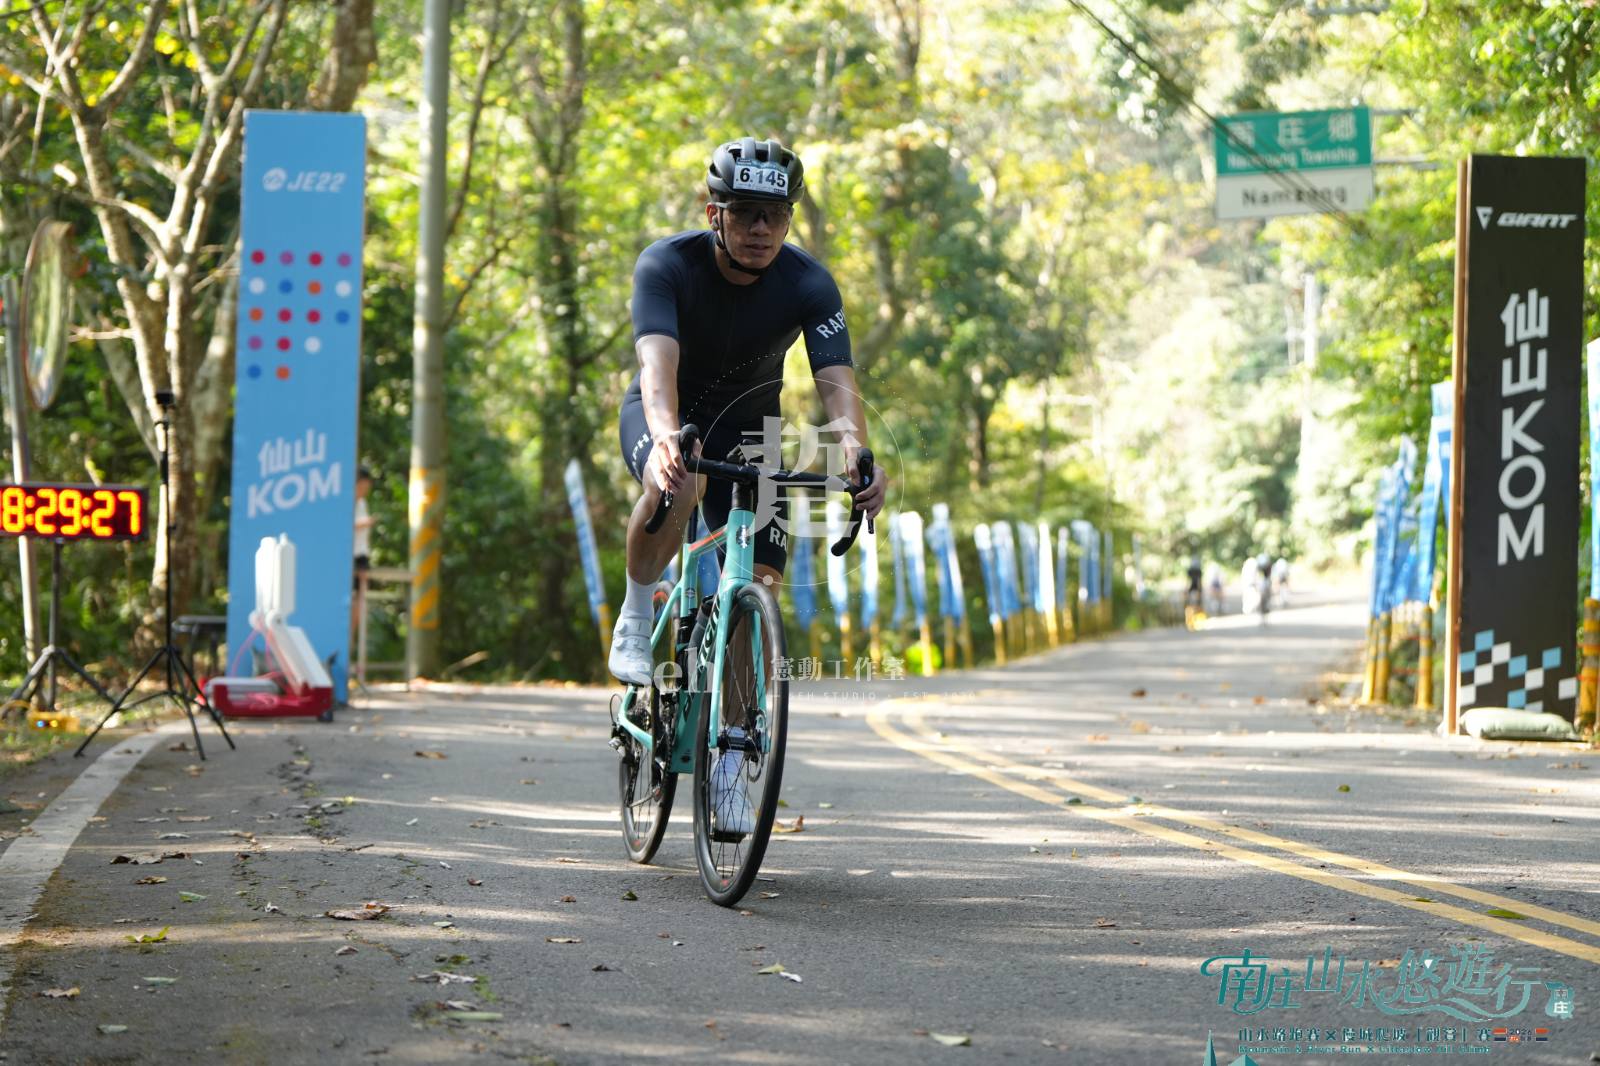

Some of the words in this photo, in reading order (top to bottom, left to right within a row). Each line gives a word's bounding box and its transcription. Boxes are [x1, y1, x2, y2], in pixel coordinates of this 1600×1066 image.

[287, 172, 346, 193] JE22
[1496, 211, 1578, 229] GIANT
[258, 429, 327, 479] 仙山
[0, 487, 141, 537] 8:29:27
[247, 461, 342, 519] KOM
